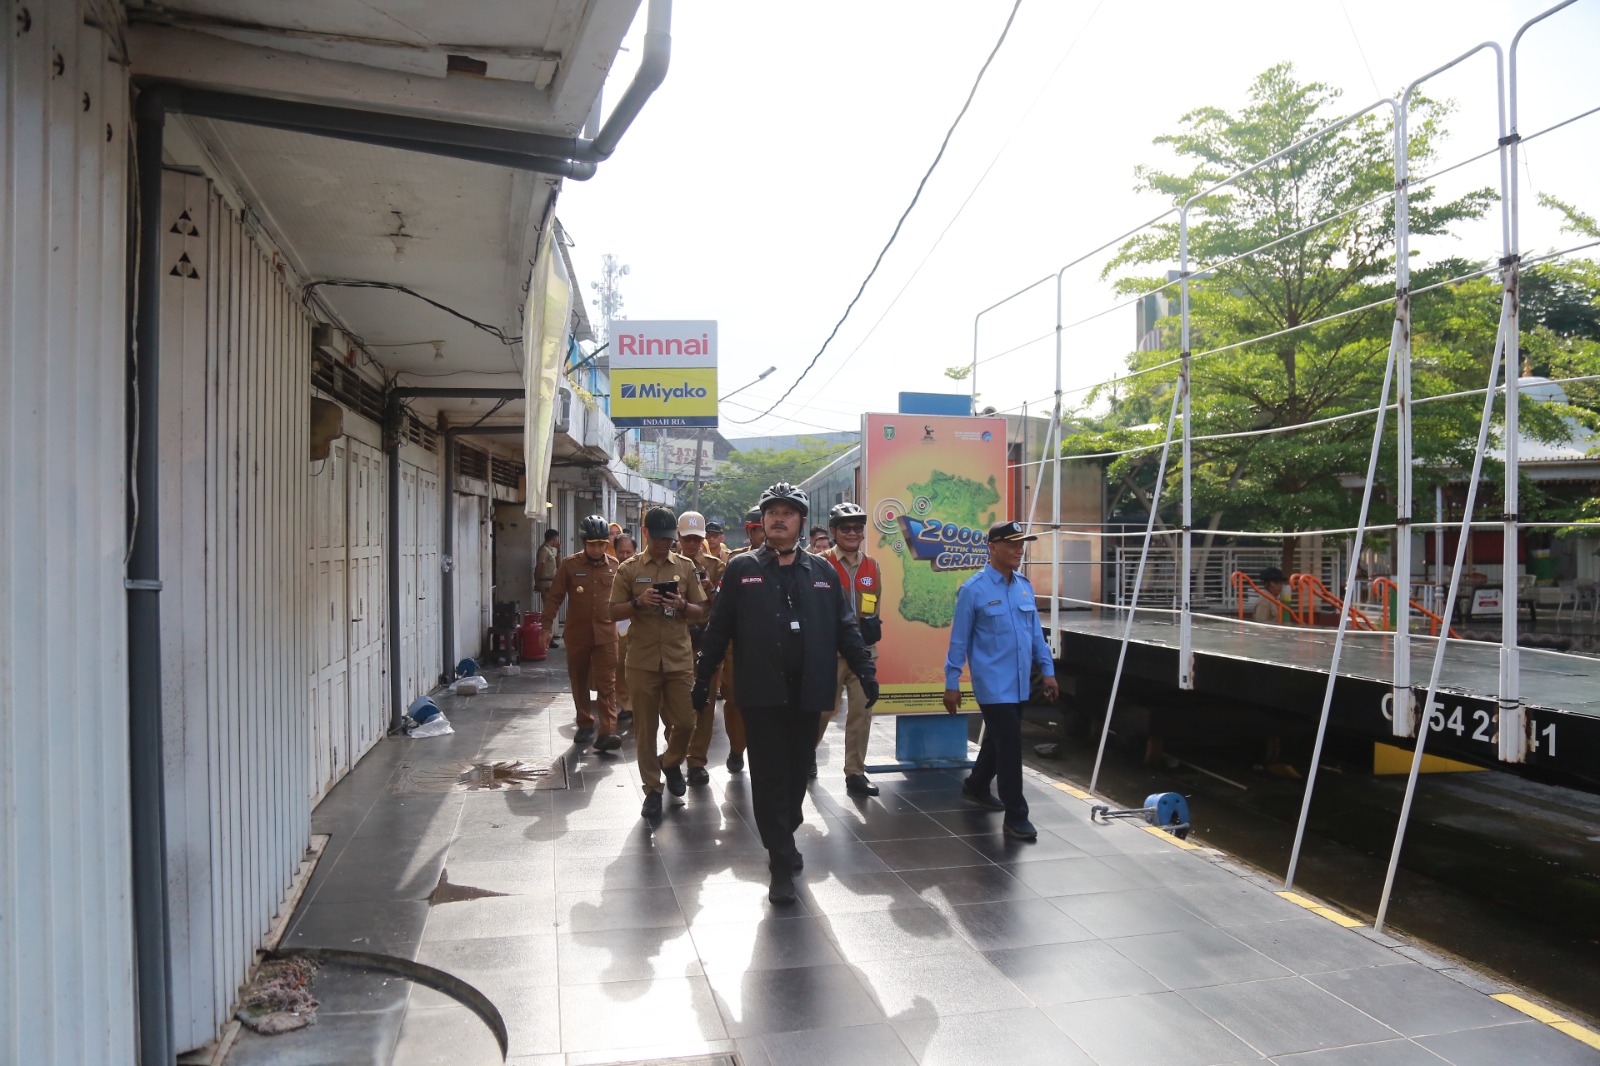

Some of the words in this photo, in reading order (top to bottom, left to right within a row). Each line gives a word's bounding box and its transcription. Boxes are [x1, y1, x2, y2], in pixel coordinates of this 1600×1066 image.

[618, 333, 709, 355] Rinnai
[639, 382, 707, 402] Miyako
[643, 418, 670, 426] INDAH
[671, 418, 686, 426] RIA
[1429, 701, 1465, 736] 54
